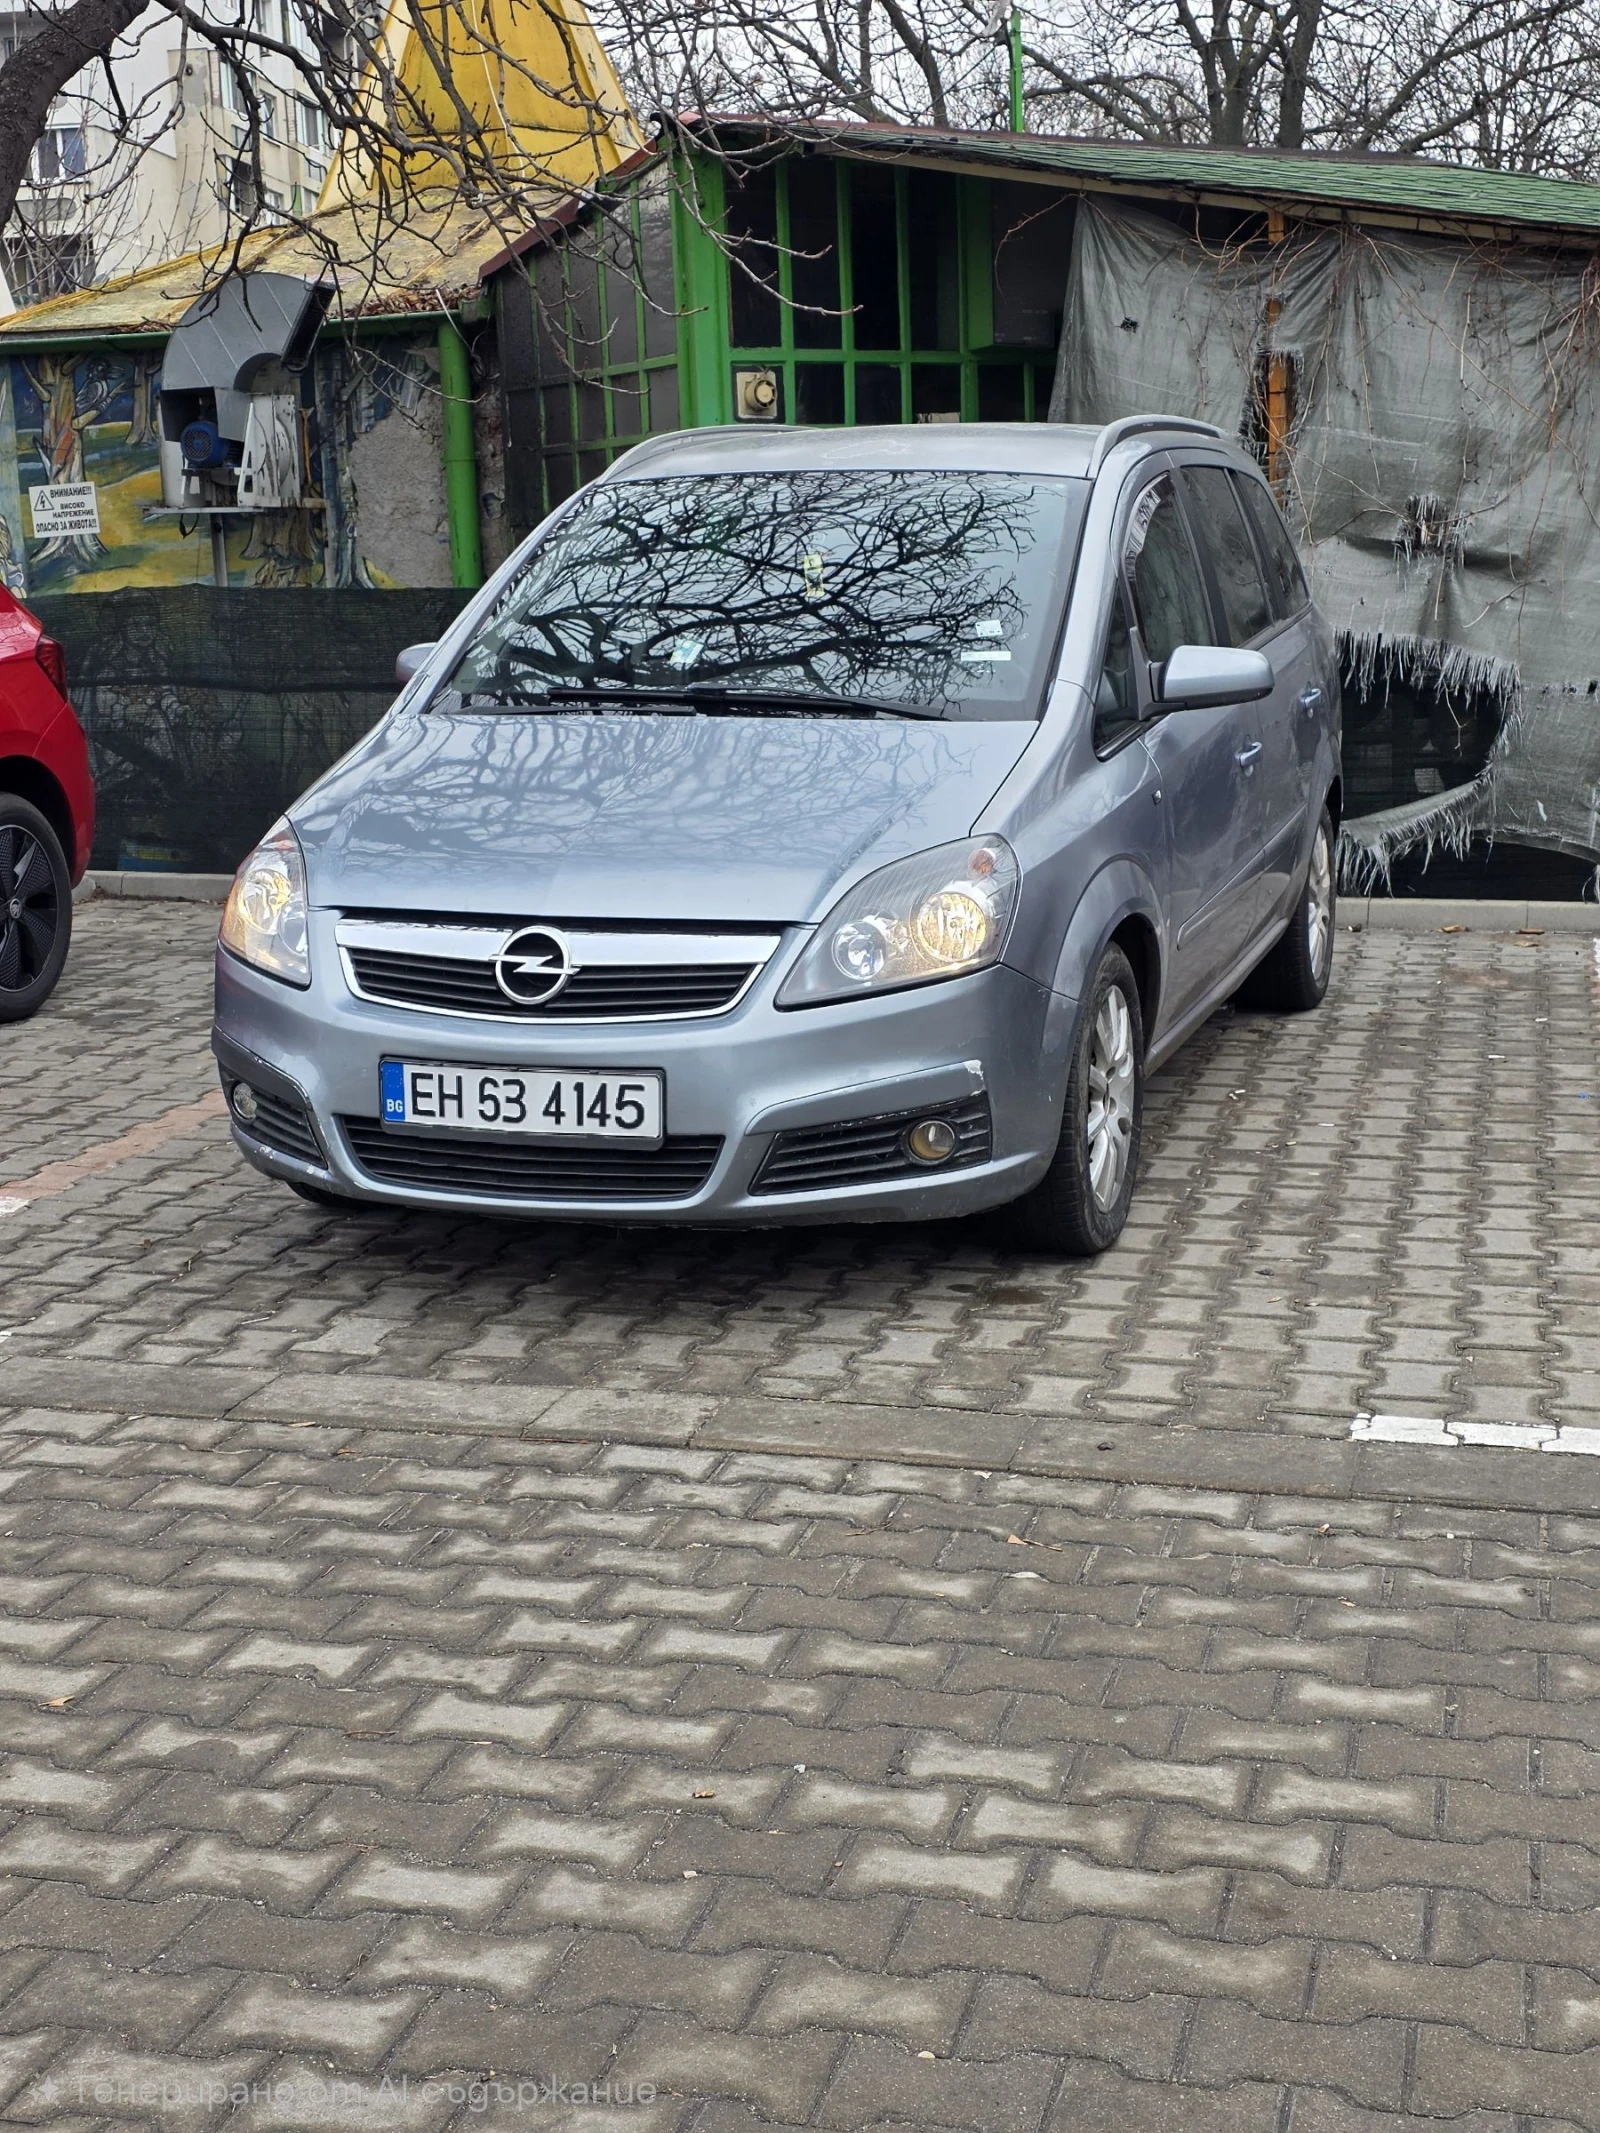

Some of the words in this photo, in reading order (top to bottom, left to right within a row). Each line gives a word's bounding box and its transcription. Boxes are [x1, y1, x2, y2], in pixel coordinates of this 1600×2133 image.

[50, 486, 92, 498] ВНИМАНИЕ!!!
[60, 502, 85, 510] ВИСОКО
[52, 509, 95, 518] НАПРЕЖЕНИЕ
[36, 521, 59, 533] ОПАСНО
[60, 521, 67, 531] ЗА
[67, 519, 97, 530] ЖИВОТА!!!
[386, 1099, 403, 1113] BG
[411, 1072, 463, 1118] EH
[542, 1081, 645, 1129] 4145
